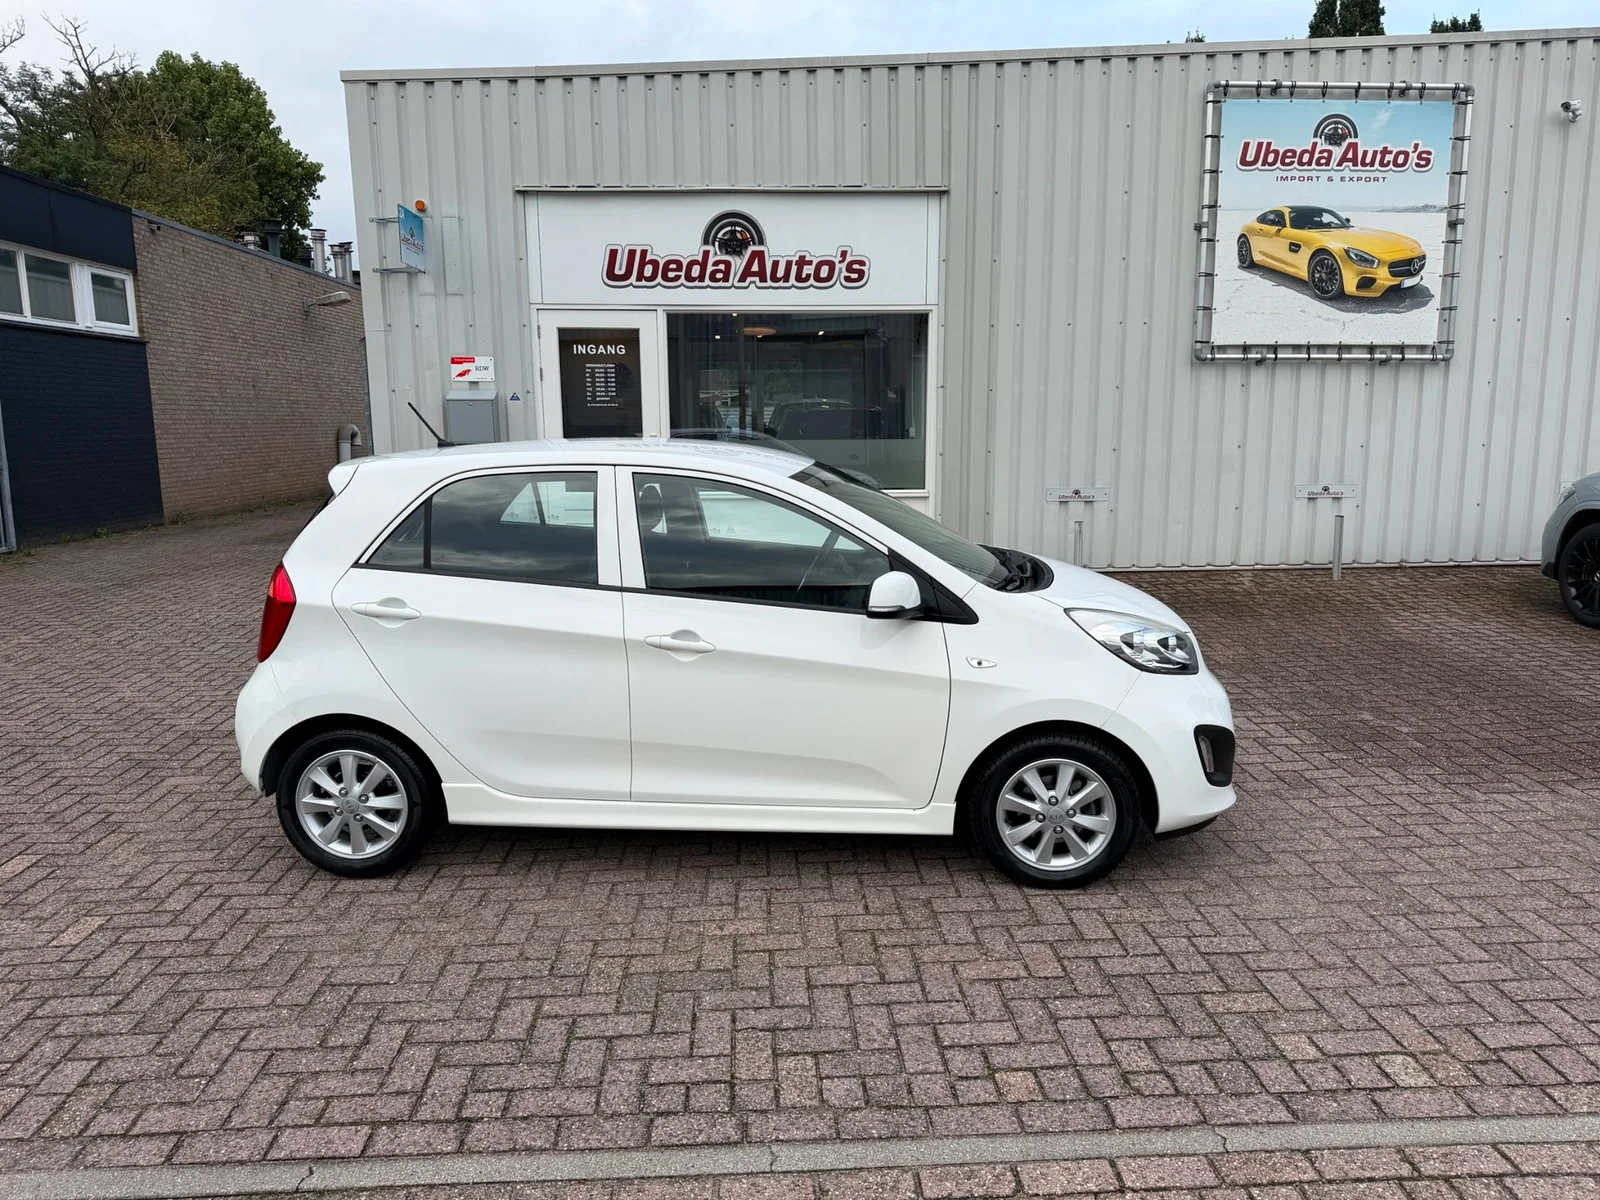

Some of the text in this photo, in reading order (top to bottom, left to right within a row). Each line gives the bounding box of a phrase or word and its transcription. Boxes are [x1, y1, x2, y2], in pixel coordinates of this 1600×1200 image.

[1237, 140, 1434, 169] Ubeda Auto's
[1275, 175, 1388, 183] IMPORT & EXPORT
[605, 247, 869, 285] Ubeda Auto's
[573, 344, 626, 355] INGANG
